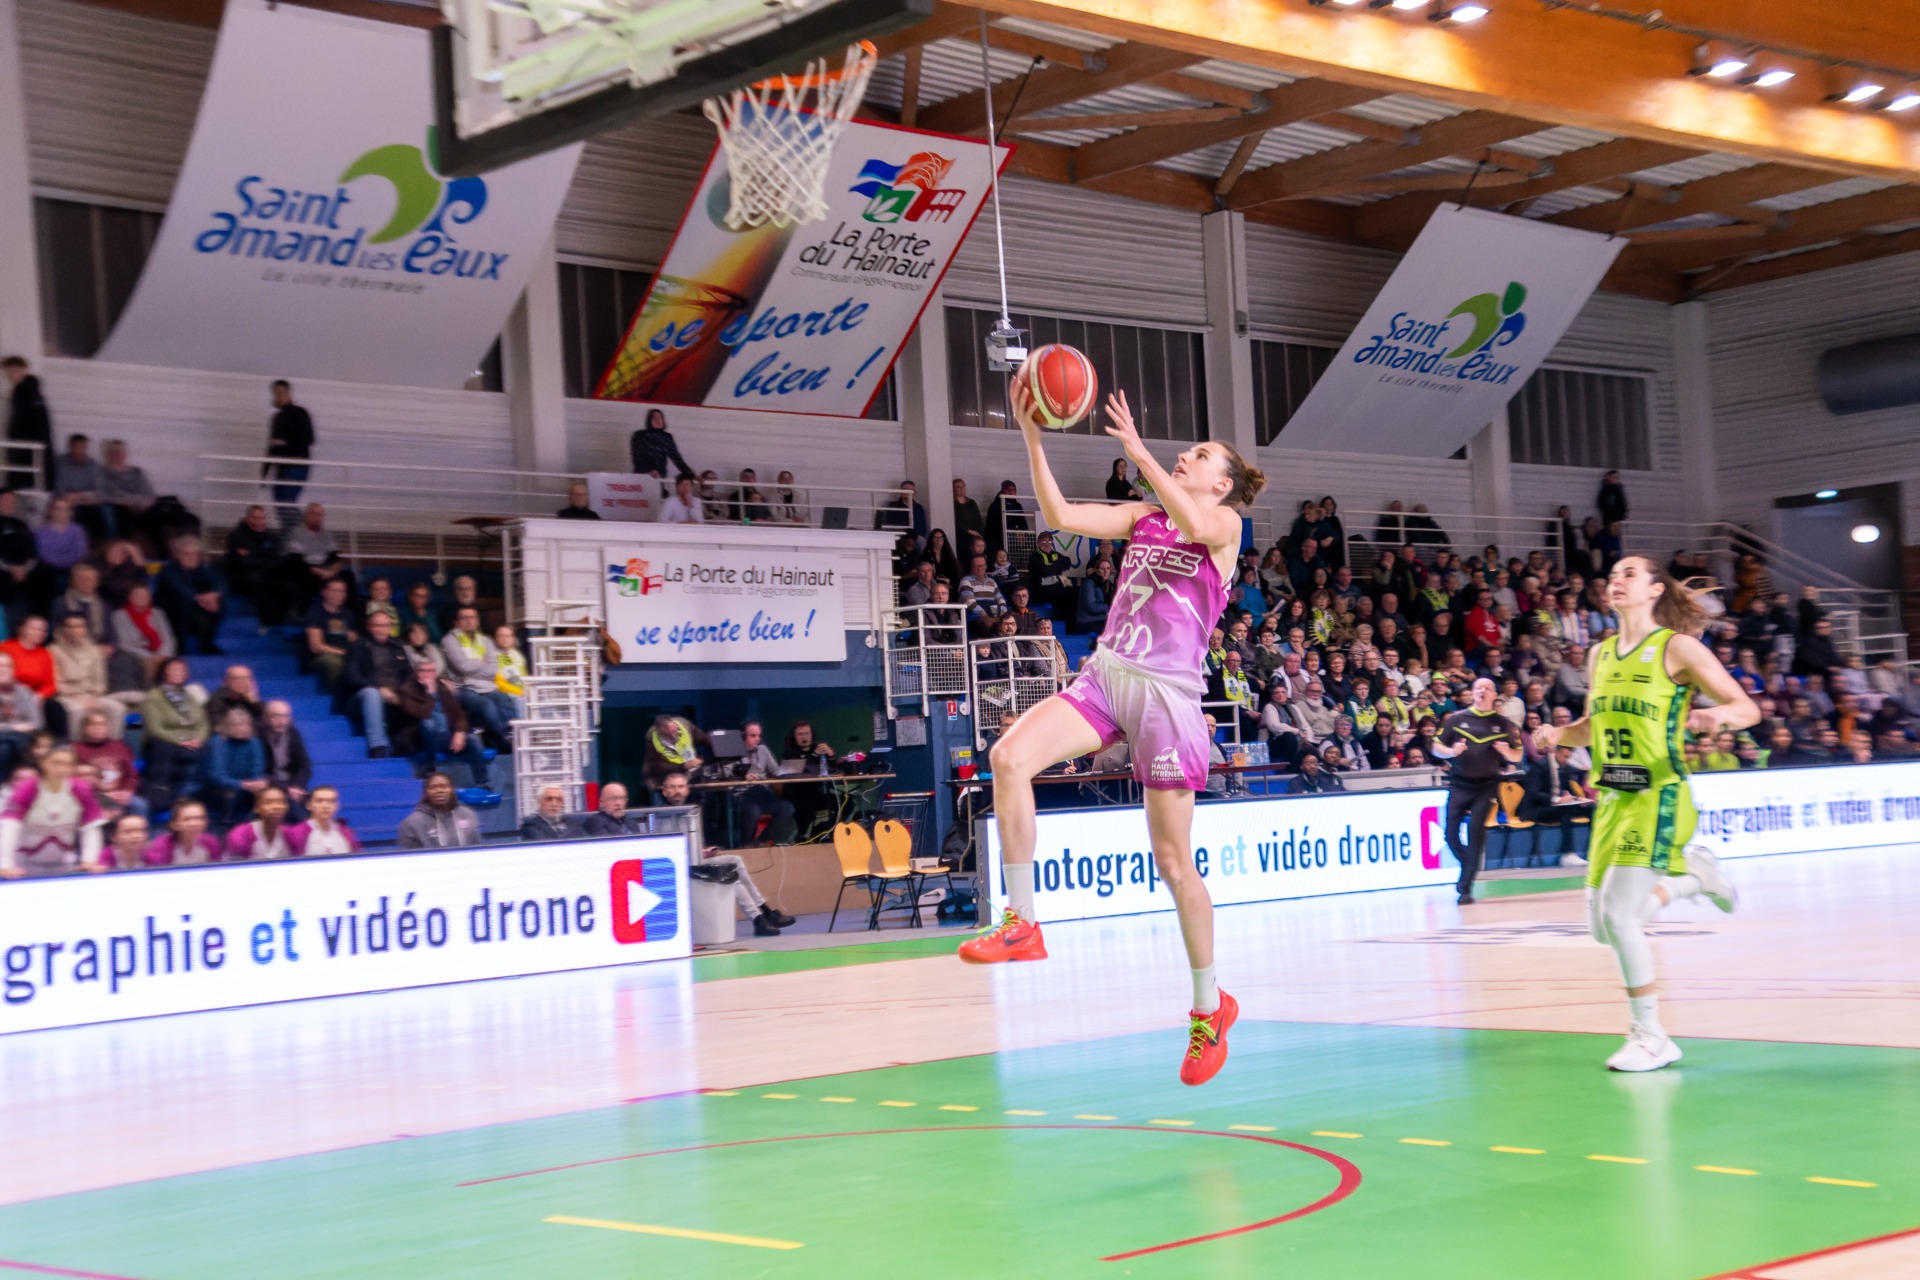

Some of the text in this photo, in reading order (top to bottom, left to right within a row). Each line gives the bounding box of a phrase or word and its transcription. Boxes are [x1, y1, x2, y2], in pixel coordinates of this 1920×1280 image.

[235, 176, 351, 230] Saint
[194, 212, 365, 267] amand
[829, 221, 931, 257] La Porte
[799, 241, 936, 279] du Hainaut
[649, 297, 870, 358] se sporte
[1386, 312, 1450, 348] Saint
[733, 346, 886, 398] bien !
[1353, 335, 1448, 373] amand
[664, 563, 834, 587] La Porte du Hainaut
[1128, 585, 1154, 616] 7
[635, 608, 816, 653] se sporte bien !
[1604, 728, 1632, 759] 36
[1220, 835, 1248, 876] et
[1257, 826, 1327, 873] vidéo
[1339, 824, 1411, 866] drone
[2, 887, 595, 1006] graphie et vidéo drone
